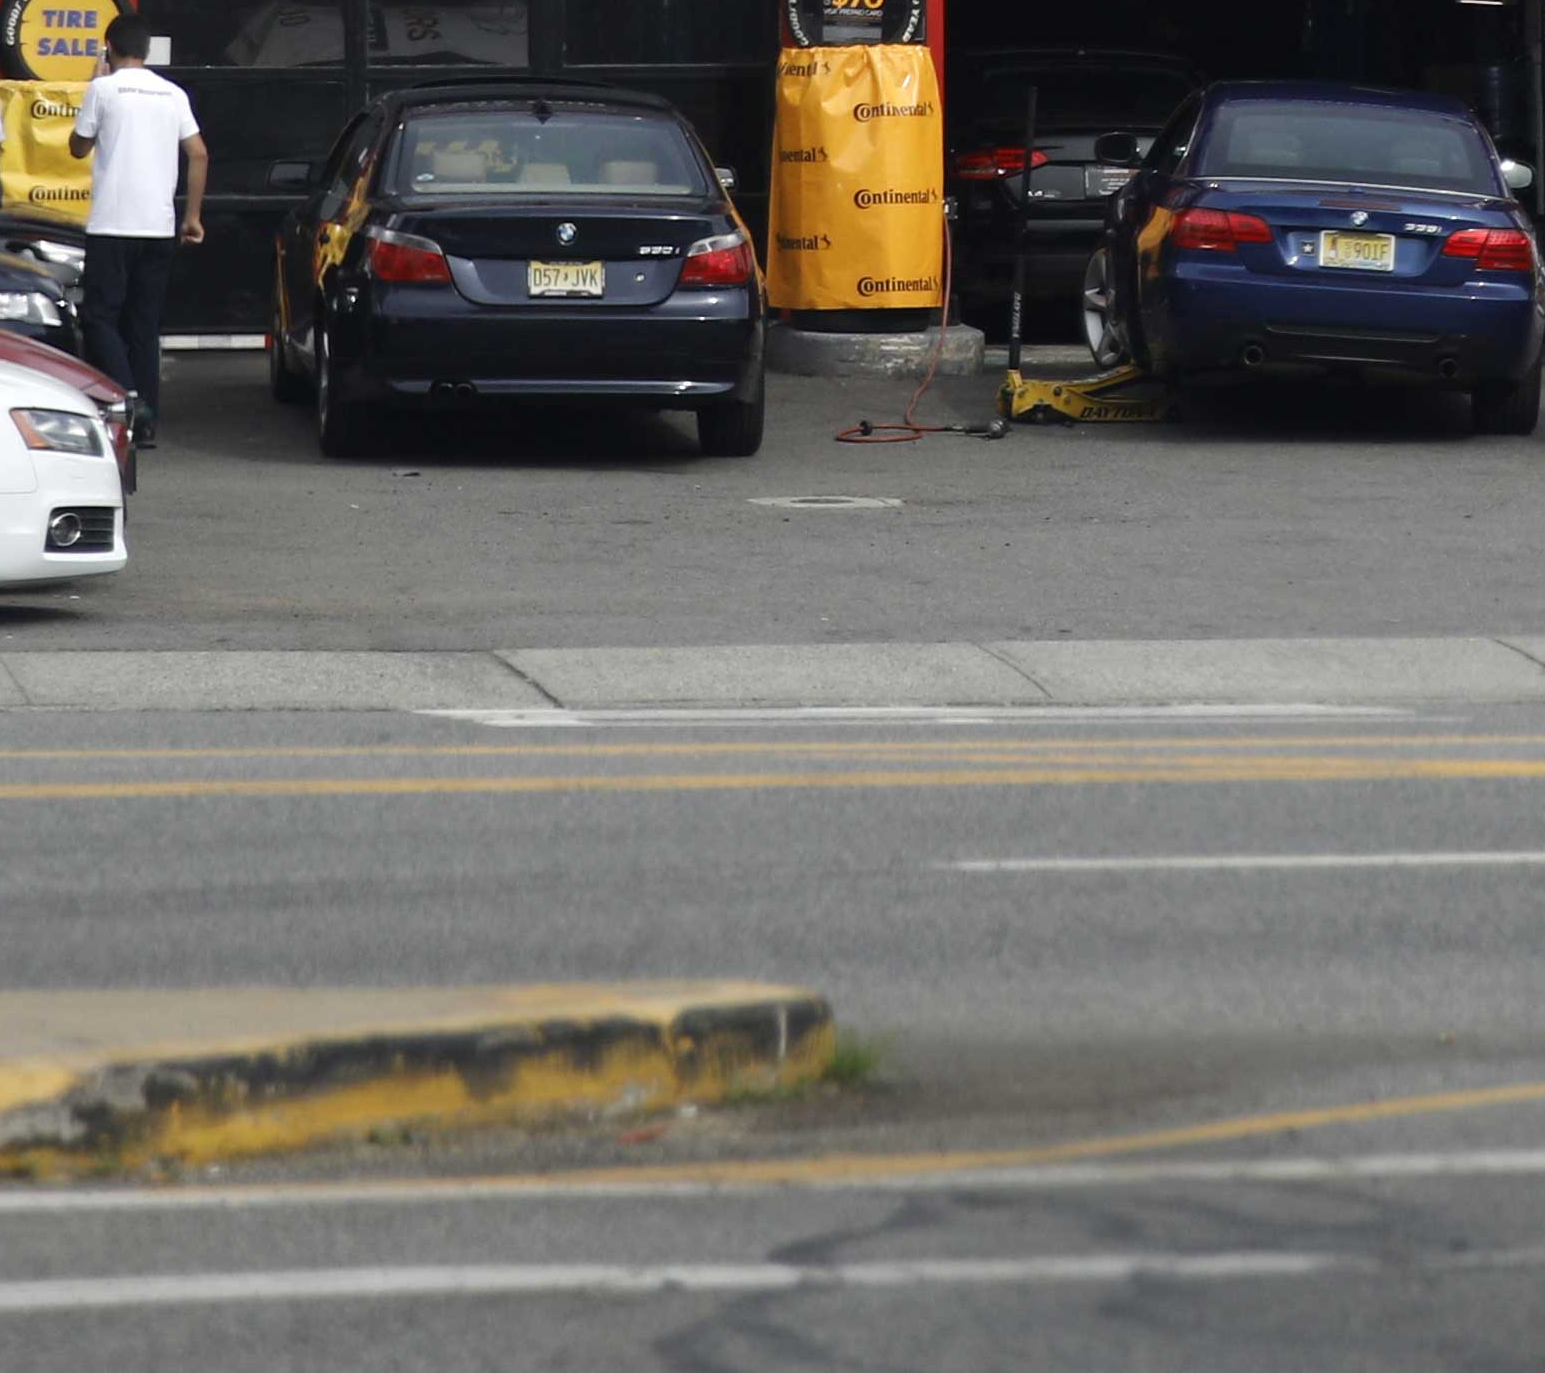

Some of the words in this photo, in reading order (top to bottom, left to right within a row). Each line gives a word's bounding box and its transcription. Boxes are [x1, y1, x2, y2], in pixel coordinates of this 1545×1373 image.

[42, 9, 98, 30] TIRE
[37, 38, 99, 57] SALE
[854, 103, 927, 122] Continental
[854, 189, 931, 209] Continental
[533, 268, 561, 287] D57
[572, 268, 599, 287] JVK
[857, 276, 933, 297] Continental
